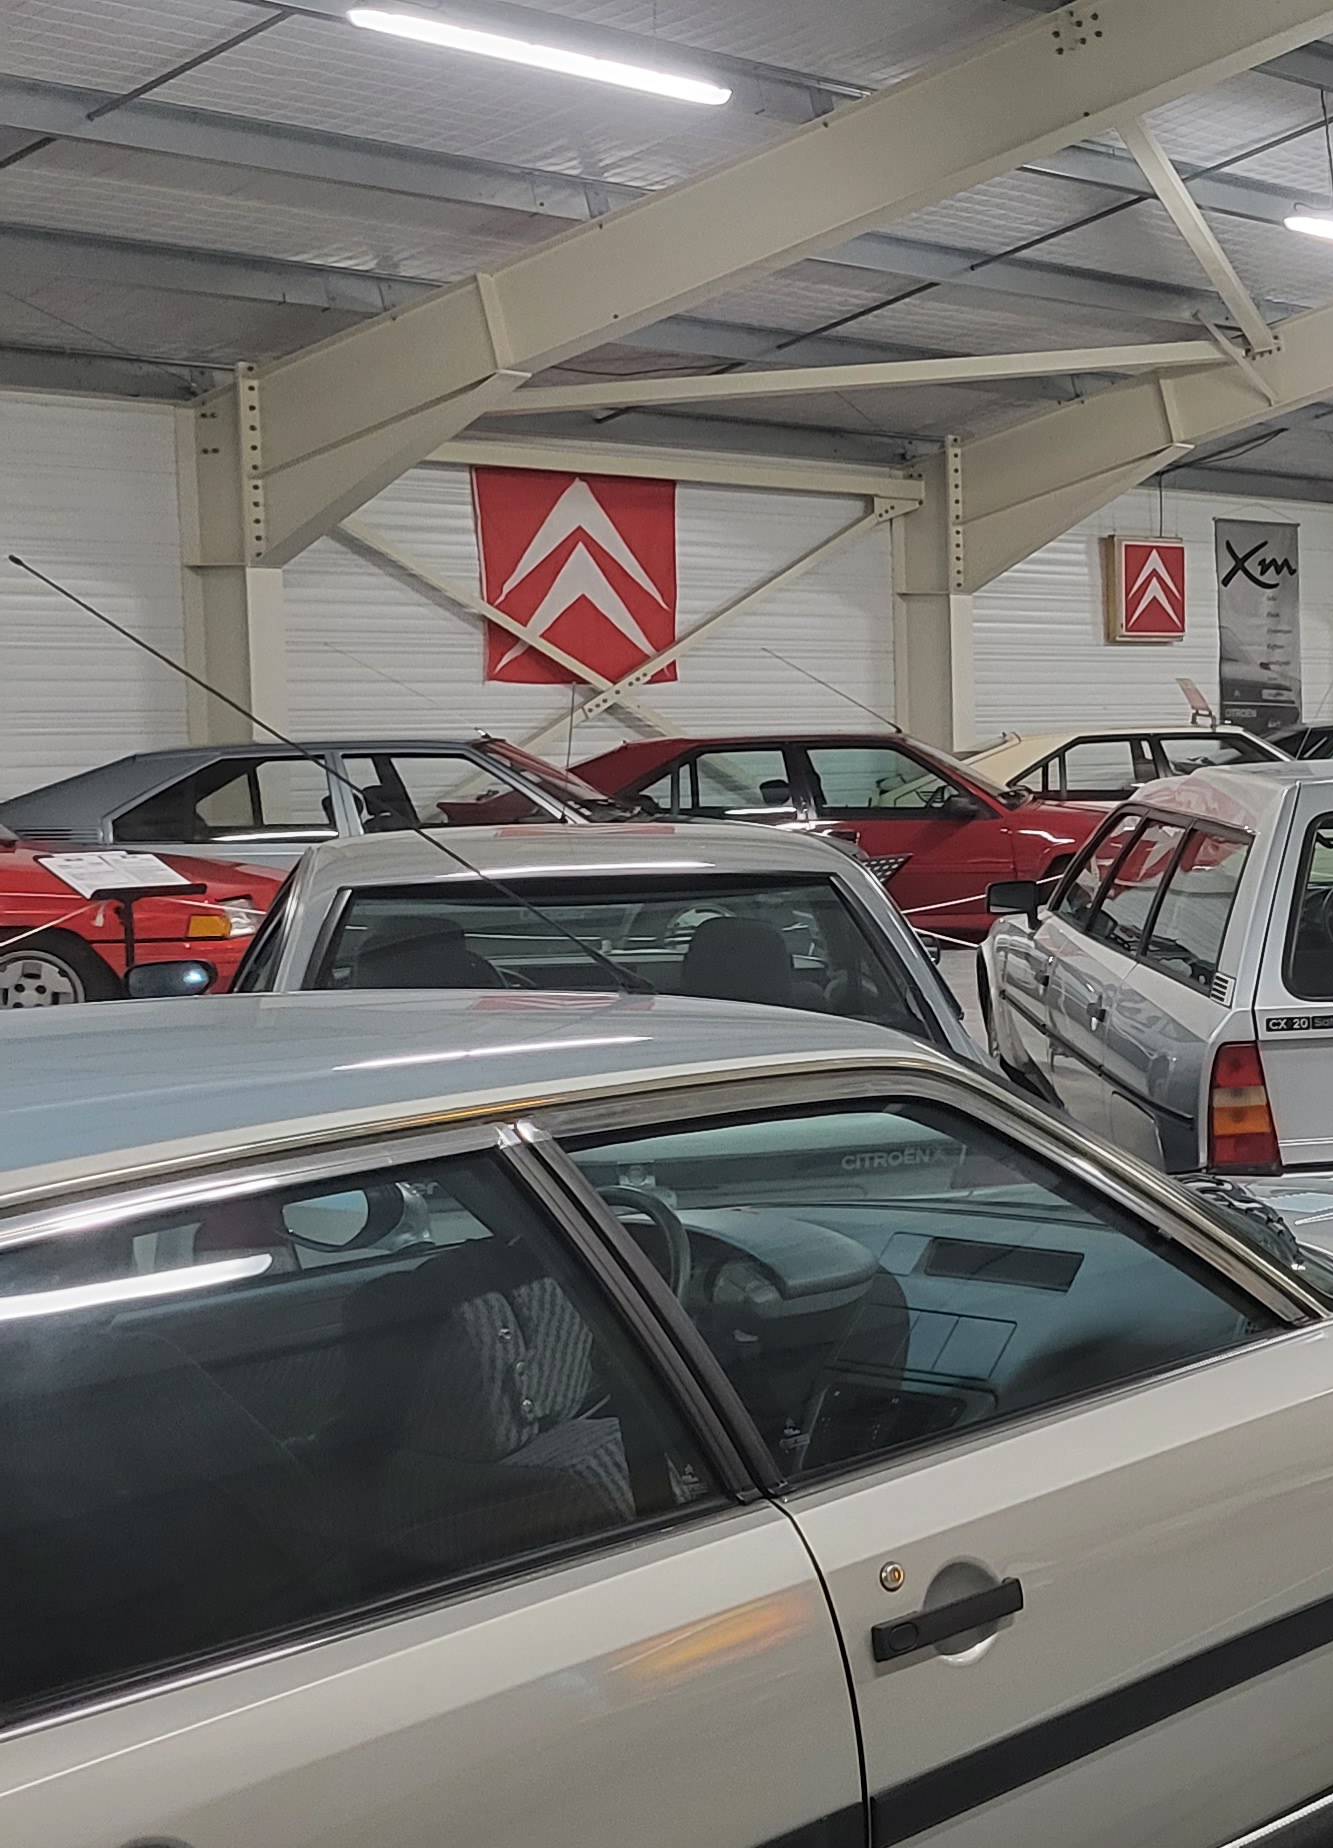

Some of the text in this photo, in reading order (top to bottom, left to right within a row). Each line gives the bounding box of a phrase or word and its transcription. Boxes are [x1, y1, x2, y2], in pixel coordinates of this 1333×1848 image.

[1221, 540, 1297, 589] Xm
[1269, 1018, 1288, 1030] CX
[1293, 1018, 1309, 1029] 20
[841, 1147, 931, 1170] CITROËN
